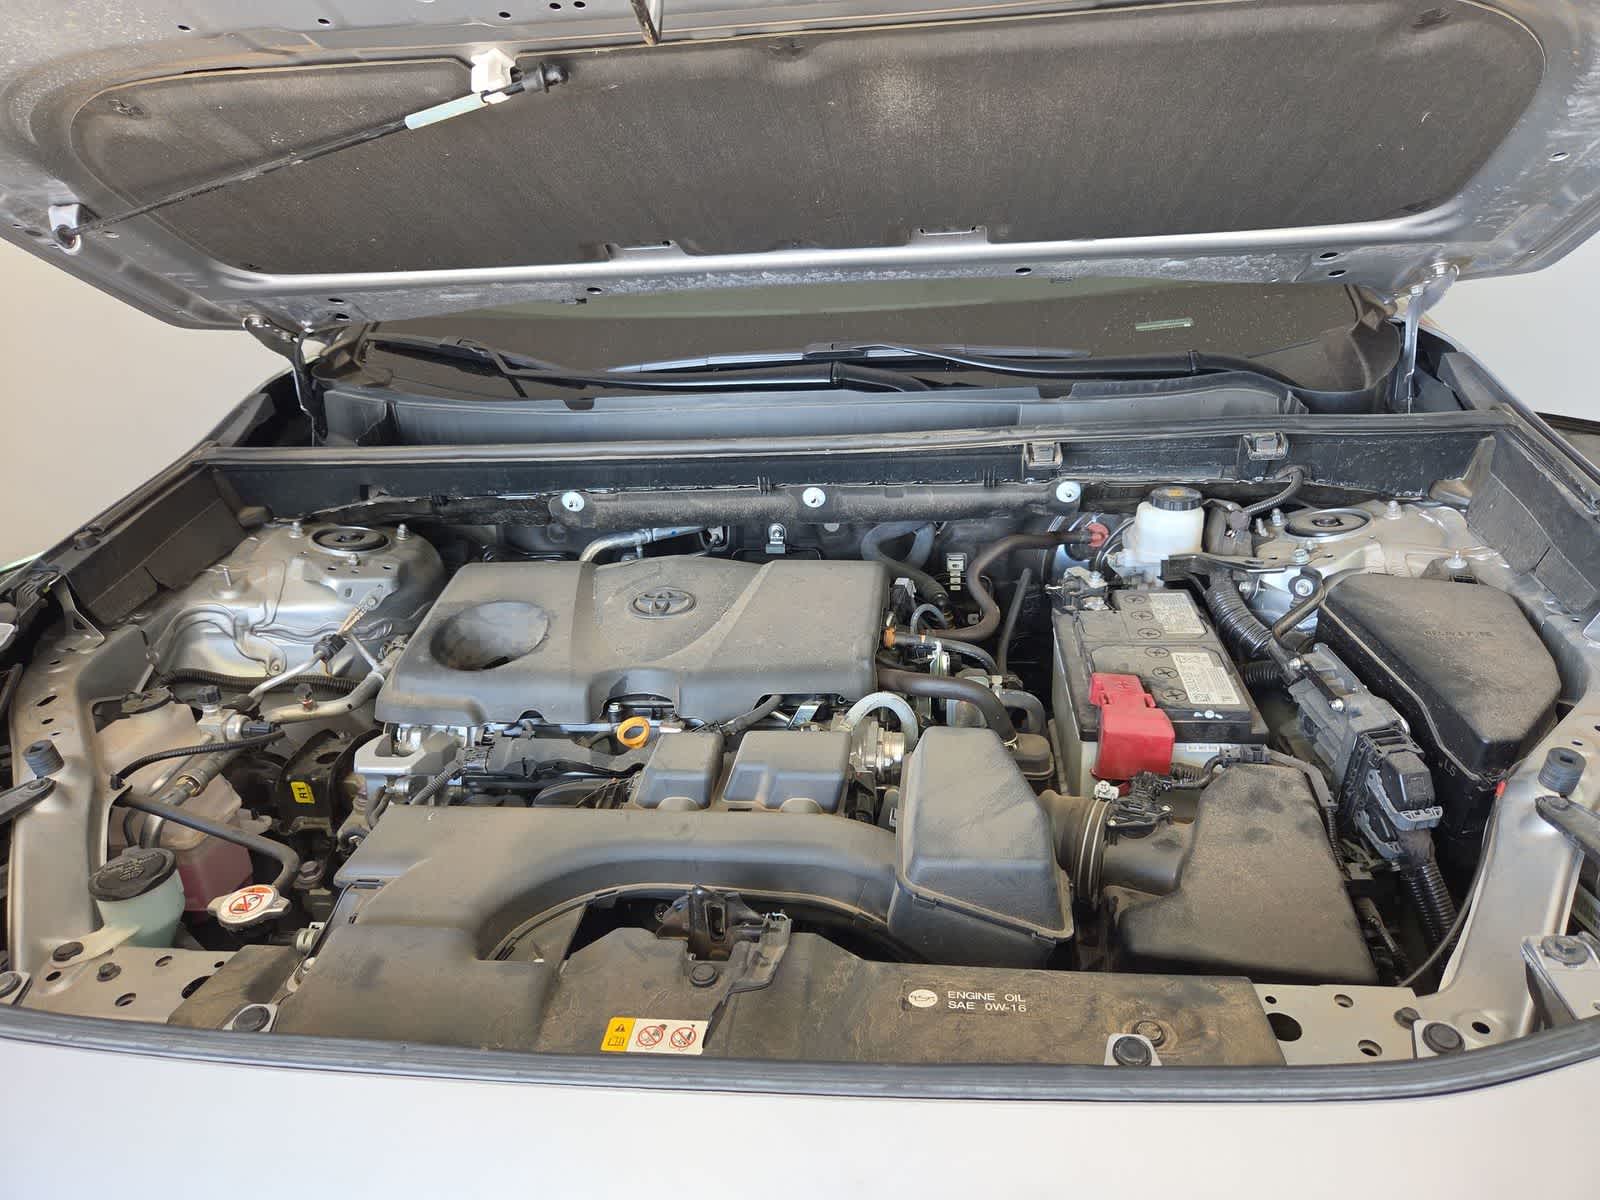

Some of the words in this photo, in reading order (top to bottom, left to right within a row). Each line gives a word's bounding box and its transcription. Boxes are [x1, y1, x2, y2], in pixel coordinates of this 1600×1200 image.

[947, 991, 996, 1001] ENGINE
[1004, 994, 1026, 1003] OIL
[947, 1001, 975, 1010] SAE
[984, 1003, 1027, 1012] 0W-16
